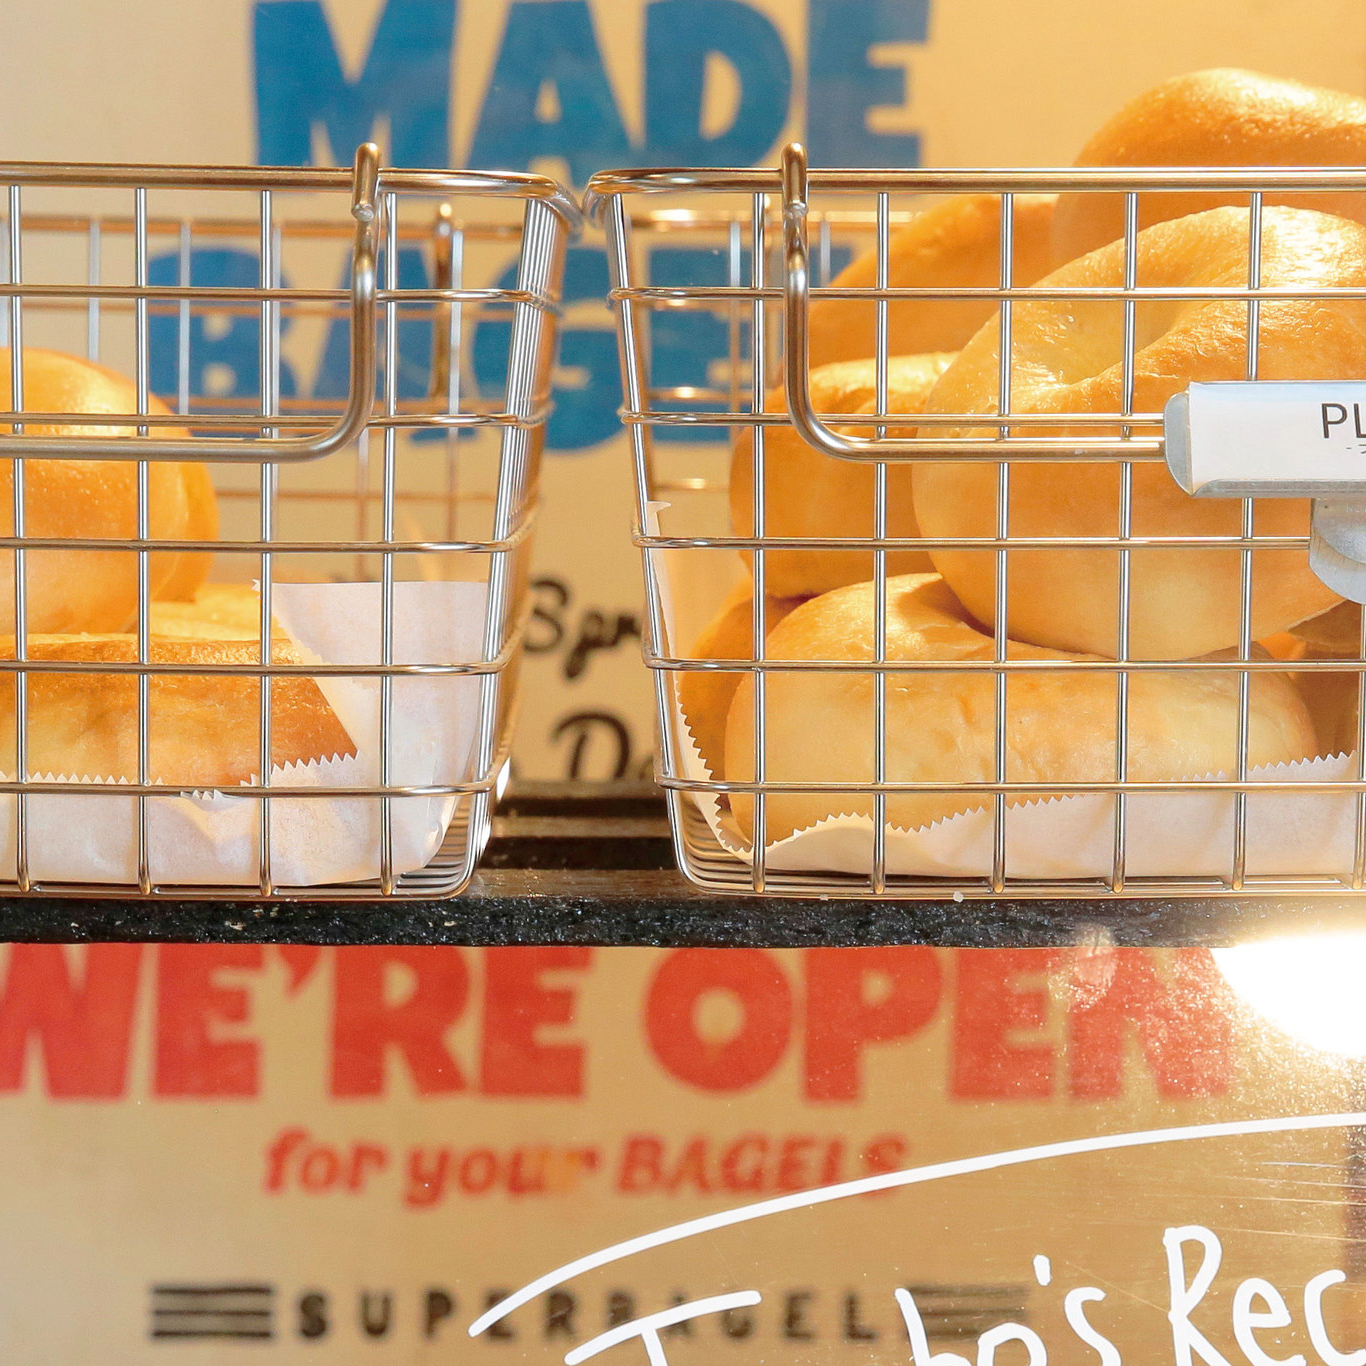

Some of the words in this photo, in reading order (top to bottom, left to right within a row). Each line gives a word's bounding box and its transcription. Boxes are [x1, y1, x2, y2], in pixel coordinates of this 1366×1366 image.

[248, 0, 933, 196] MADE
[643, 945, 1238, 1105] OPEN
[262, 1125, 388, 1196] for
[403, 1140, 601, 1209] your
[615, 1132, 911, 1201] BAGELS
